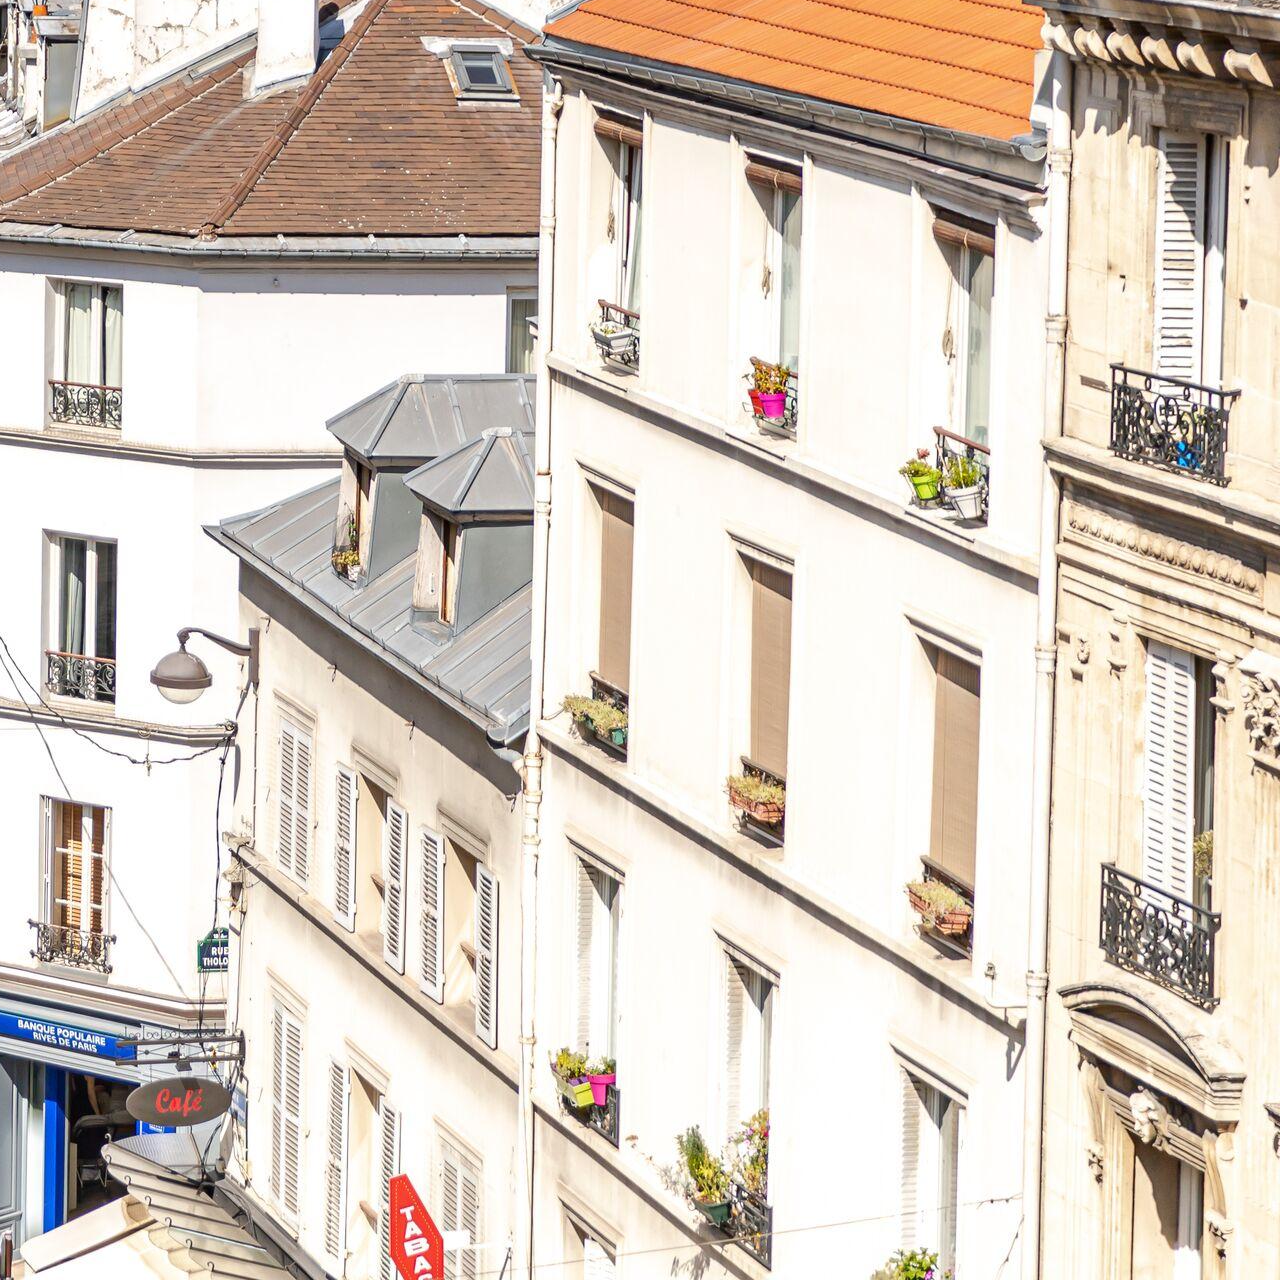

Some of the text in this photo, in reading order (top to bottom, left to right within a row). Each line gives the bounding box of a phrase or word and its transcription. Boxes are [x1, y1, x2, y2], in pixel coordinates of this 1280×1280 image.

[211, 946, 229, 956] RUE
[17, 1019, 106, 1046] BANQUE POPULAIRE
[32, 1031, 98, 1053] RIVES DE PARIS
[155, 1087, 204, 1117] Café
